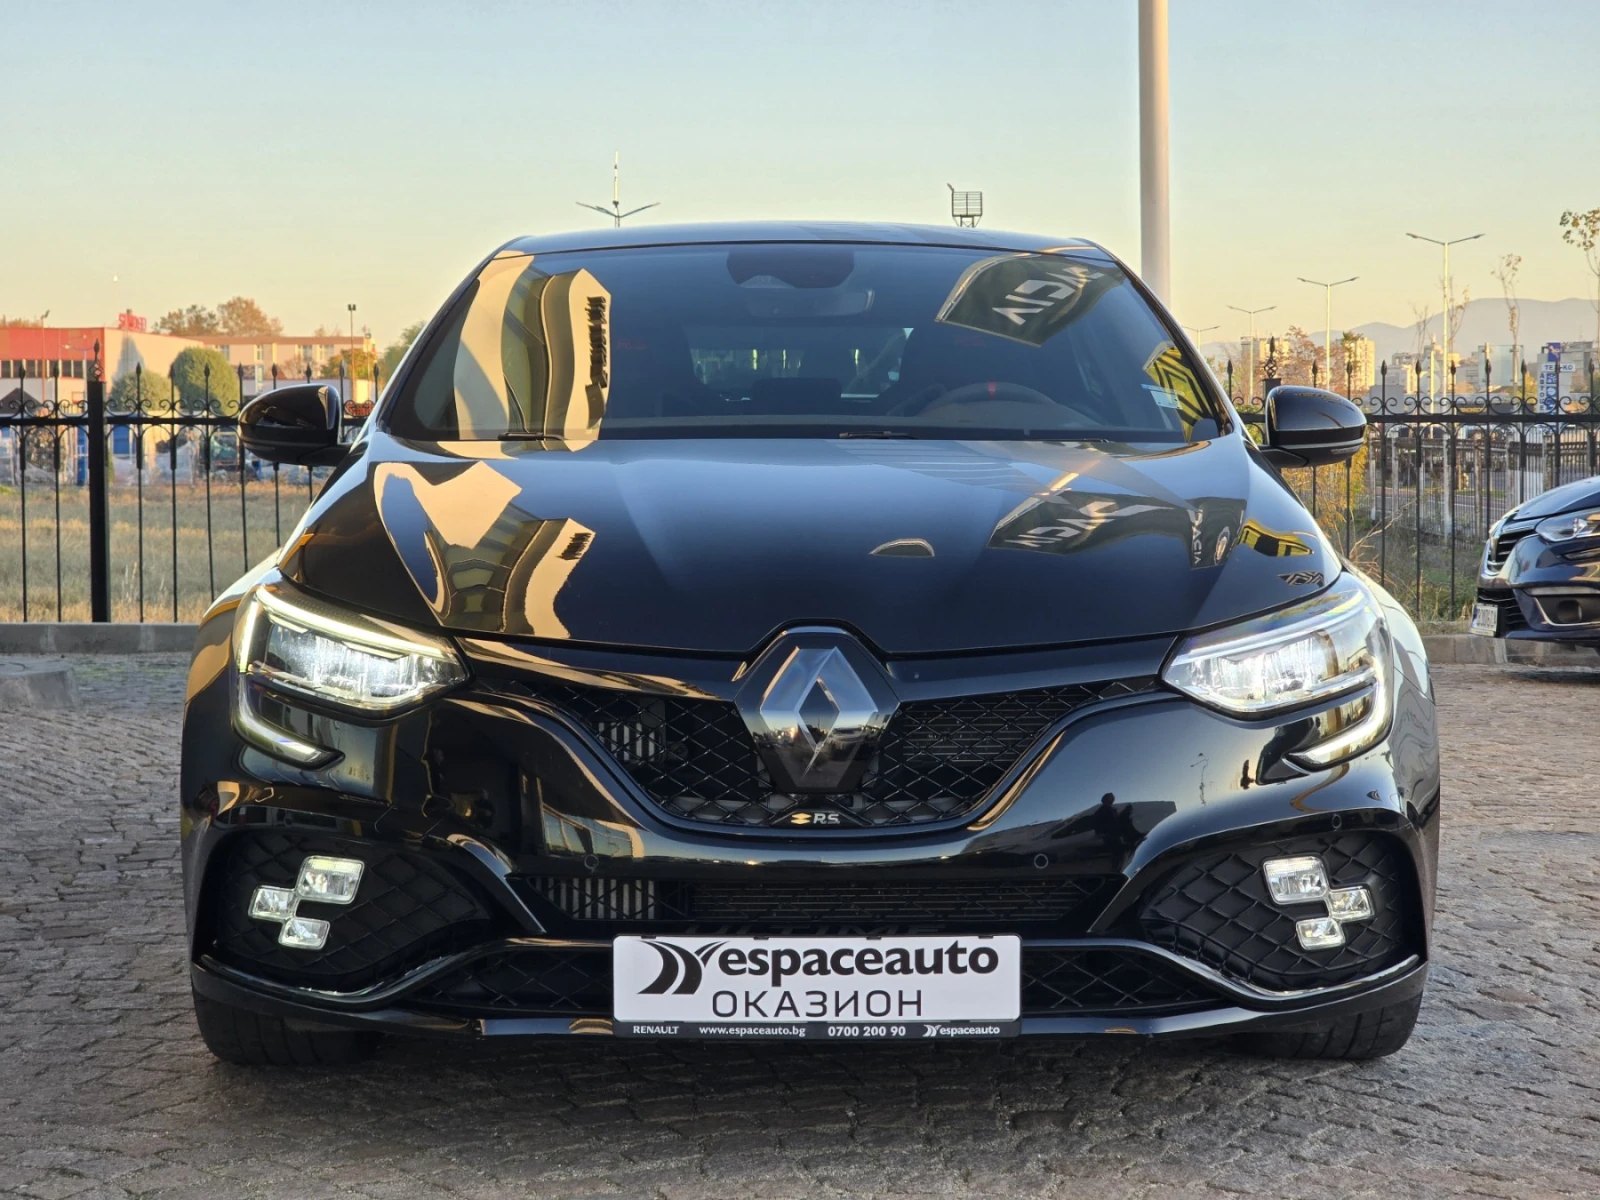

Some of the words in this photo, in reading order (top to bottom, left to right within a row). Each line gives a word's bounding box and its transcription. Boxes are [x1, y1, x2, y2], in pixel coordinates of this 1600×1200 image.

[718, 940, 1000, 987] espaceauto
[712, 989, 922, 1017] ОКАЗИОН
[633, 1025, 679, 1035] RENAULT
[699, 1025, 806, 1037] www.espaceauto.bg
[828, 1026, 859, 1037] 0700
[863, 1026, 886, 1037] 200
[890, 1026, 906, 1037] 90
[940, 1025, 1000, 1037] espaceauto
